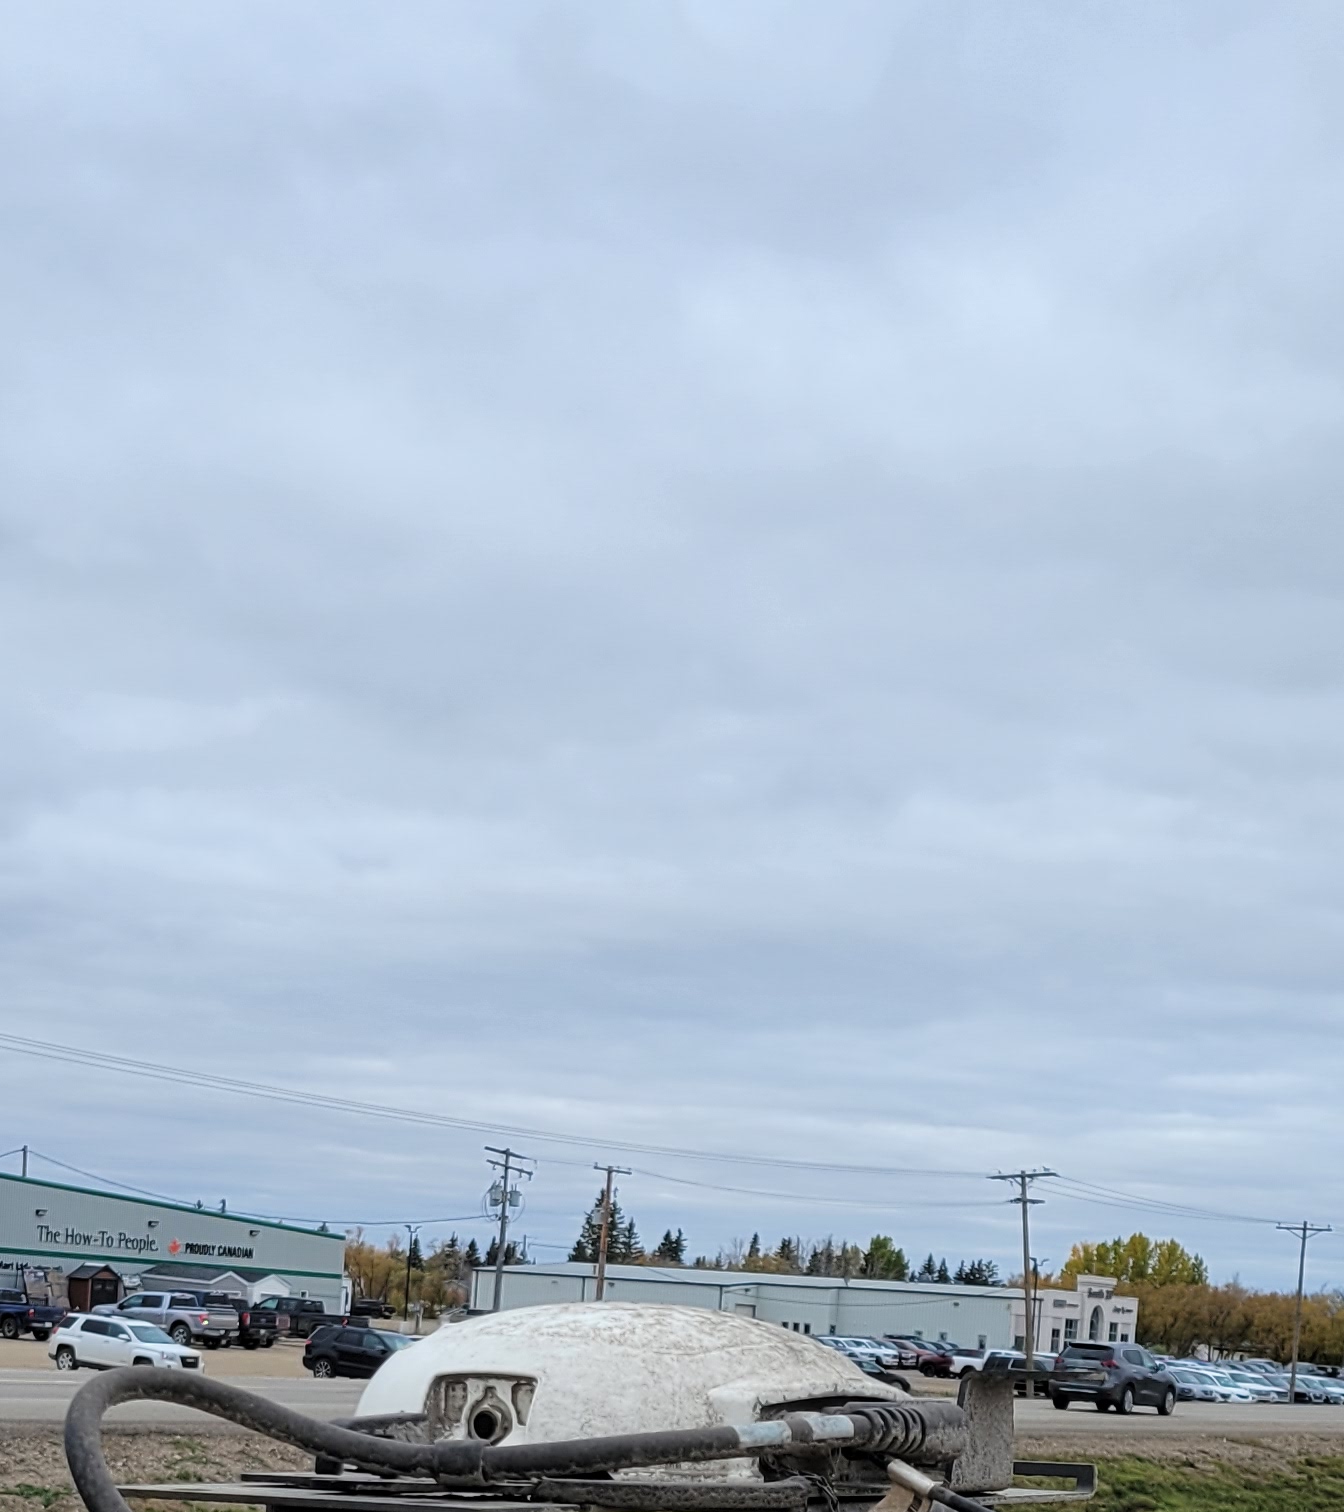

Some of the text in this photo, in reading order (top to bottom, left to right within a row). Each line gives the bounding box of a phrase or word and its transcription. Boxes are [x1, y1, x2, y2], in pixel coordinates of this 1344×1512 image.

[37, 1225, 61, 1244] The
[65, 1227, 114, 1248] How-To
[185, 1242, 255, 1259] PROUDLY CANADIAN
